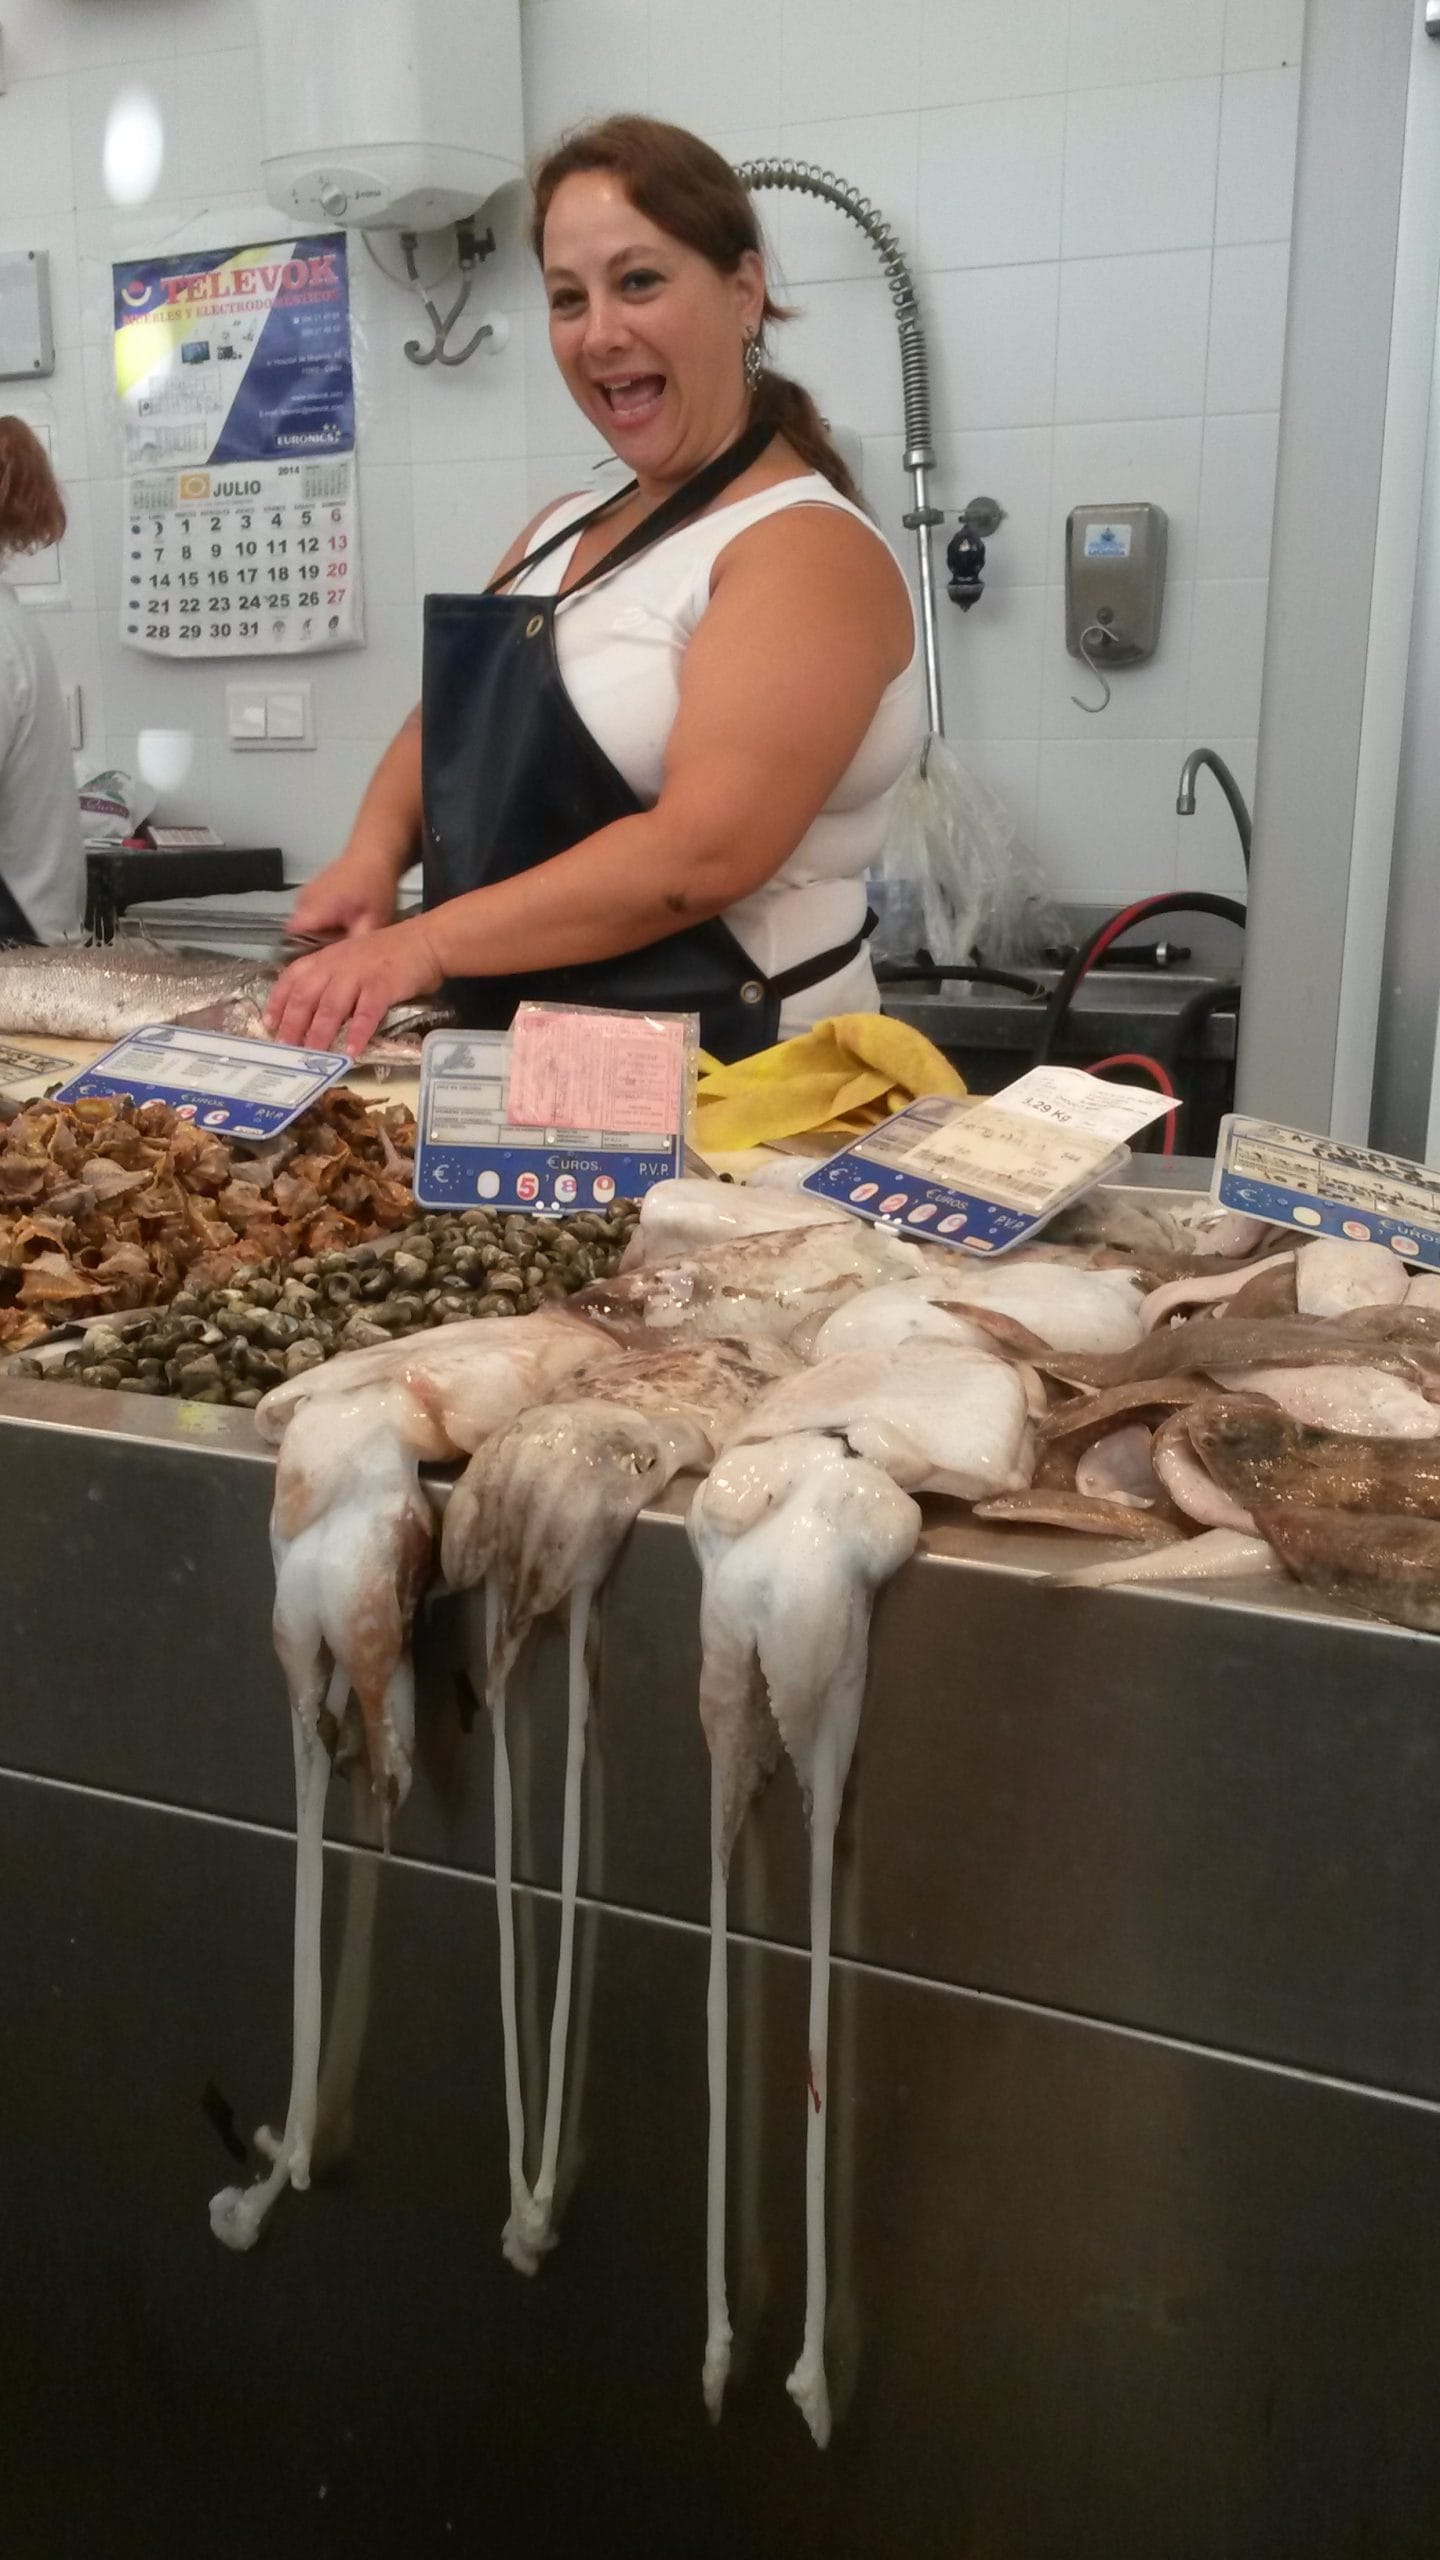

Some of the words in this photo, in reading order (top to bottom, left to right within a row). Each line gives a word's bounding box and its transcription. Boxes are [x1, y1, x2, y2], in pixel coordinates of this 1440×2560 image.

[160, 254, 339, 305] TELEVOK
[277, 432, 335, 446] EURONICS
[278, 466, 300, 476] 2014
[213, 480, 262, 497] JULIO
[182, 519, 190, 533] 1
[210, 516, 221, 531] 2
[241, 515, 251, 529] 3
[271, 513, 282, 527] 4
[302, 511, 312, 525] 5
[331, 508, 342, 522] 6
[154, 548, 164, 562] 7
[182, 545, 192, 559] 8
[211, 543, 221, 558] 9
[235, 541, 257, 556] 10
[266, 539, 288, 554] 11
[297, 537, 319, 552] 12
[328, 535, 348, 551] 13
[149, 574, 171, 588] 14
[178, 572, 199, 586] 15
[208, 570, 229, 584] 16
[237, 568, 258, 583] 17
[268, 567, 289, 581] 18
[299, 565, 320, 580] 19
[327, 563, 347, 577] 20
[148, 599, 170, 613] 21
[179, 598, 200, 612] 22
[209, 597, 231, 611] 23
[239, 595, 261, 610] 24
[269, 594, 290, 608] 25
[298, 592, 320, 606] 26
[327, 589, 346, 604] 27
[146, 625, 170, 638] 28
[179, 624, 201, 639] 29
[210, 623, 231, 637] 30
[239, 622, 259, 636] 31
[1050, 1107, 1073, 1123] Kg
[639, 1161, 670, 1176] P.V.P.
